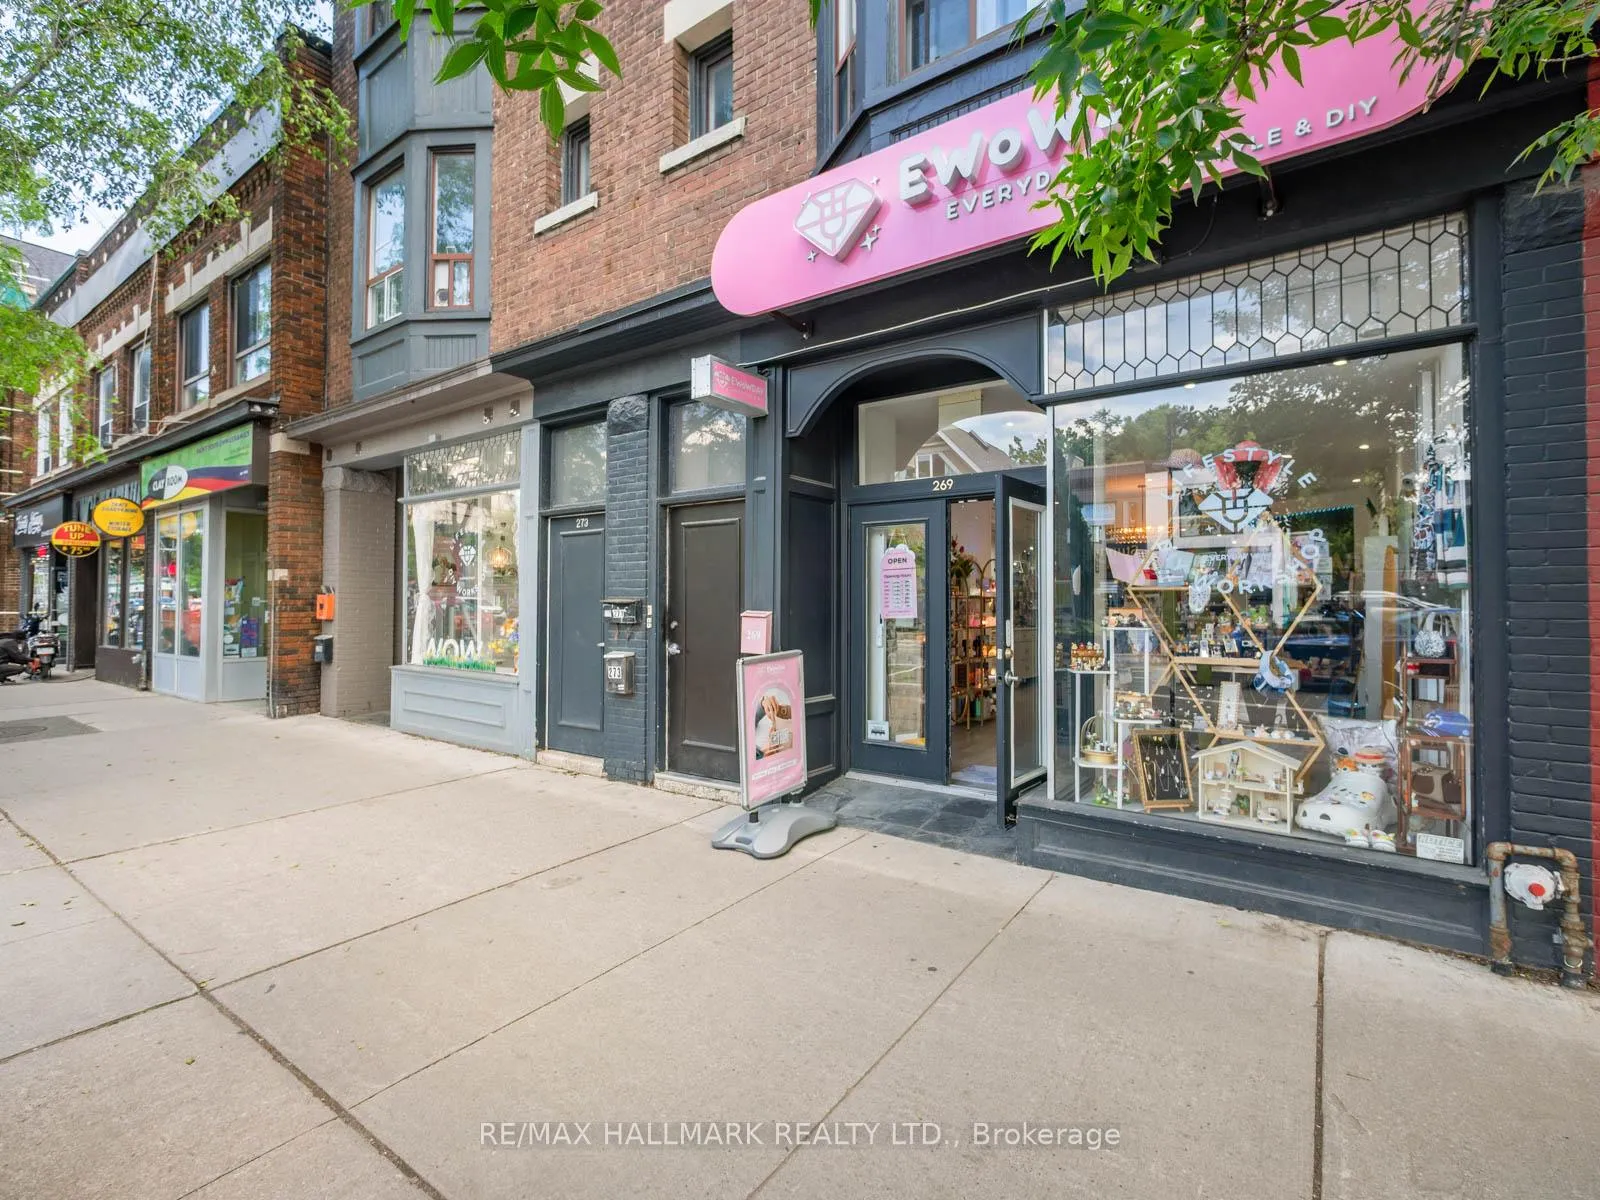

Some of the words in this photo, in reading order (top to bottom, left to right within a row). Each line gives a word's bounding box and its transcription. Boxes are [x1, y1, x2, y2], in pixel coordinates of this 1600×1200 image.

[899, 90, 1121, 204] EWoW
[946, 168, 1066, 220] EVERYD
[1295, 118, 1312, 137] &
[1326, 96, 1379, 129] DIY
[932, 479, 954, 491] 269
[63, 524, 93, 533] TUNE
[576, 518, 589, 528] 273
[70, 532, 85, 540] UP
[608, 666, 621, 679] 273
